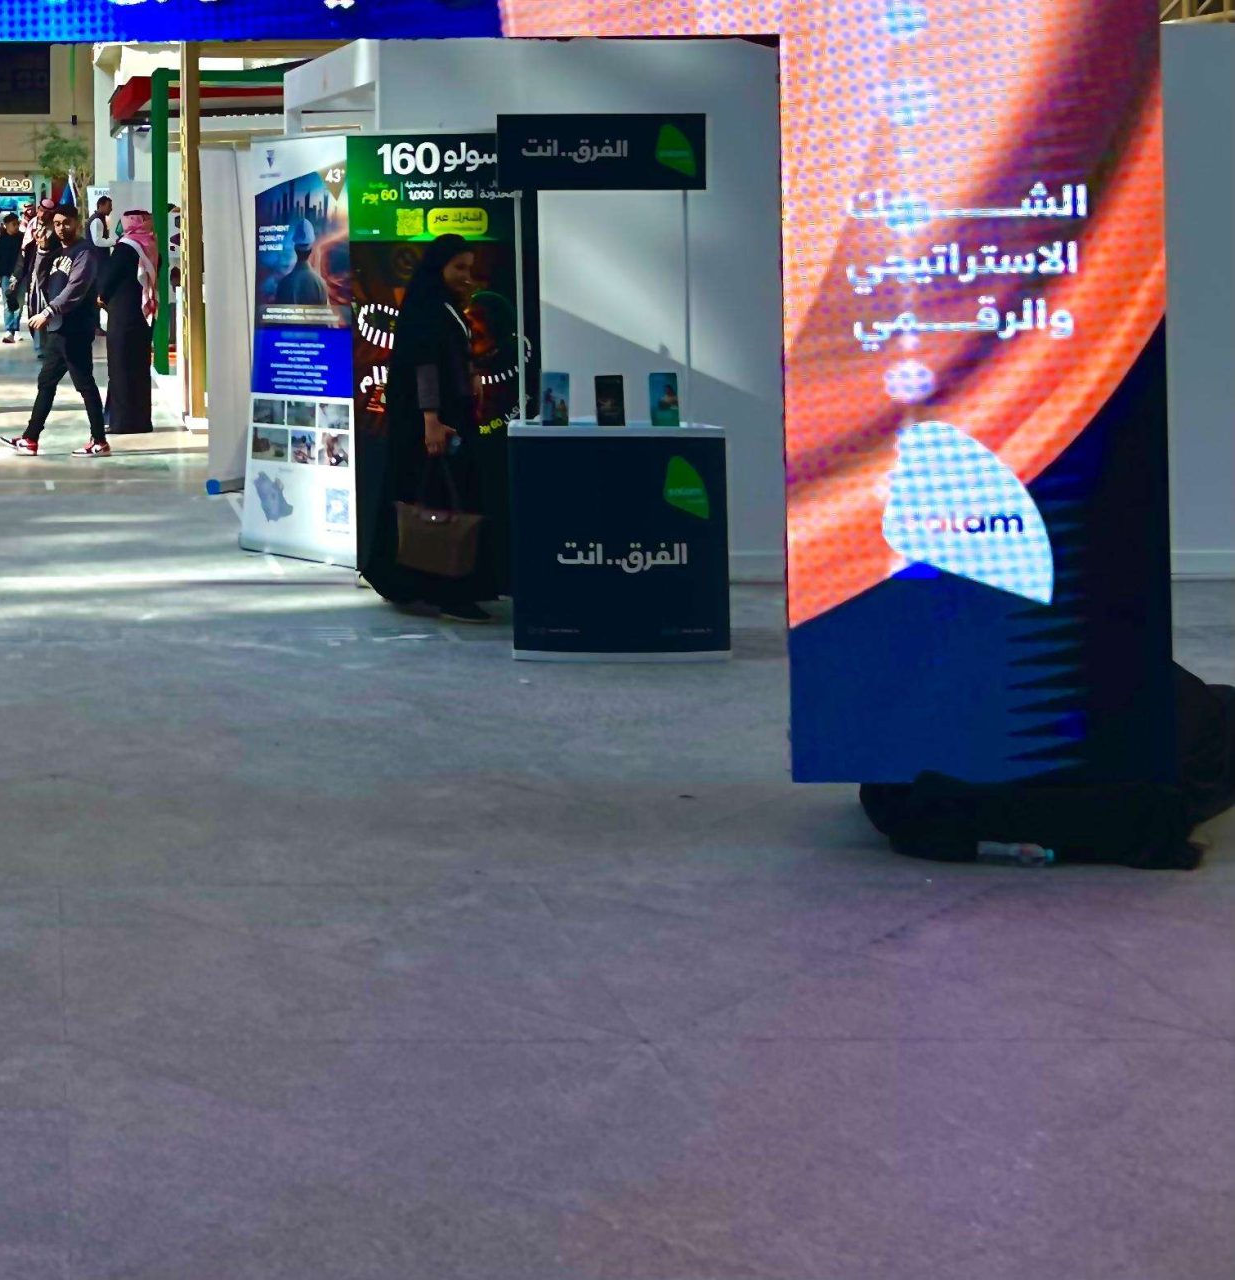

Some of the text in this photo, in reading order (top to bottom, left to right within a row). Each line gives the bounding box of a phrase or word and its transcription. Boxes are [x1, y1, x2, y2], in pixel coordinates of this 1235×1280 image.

[377, 142, 441, 175] 160
[380, 189, 398, 201] 60
[443, 189, 474, 199] 50 GB
[853, 295, 1074, 351] والرقمي
